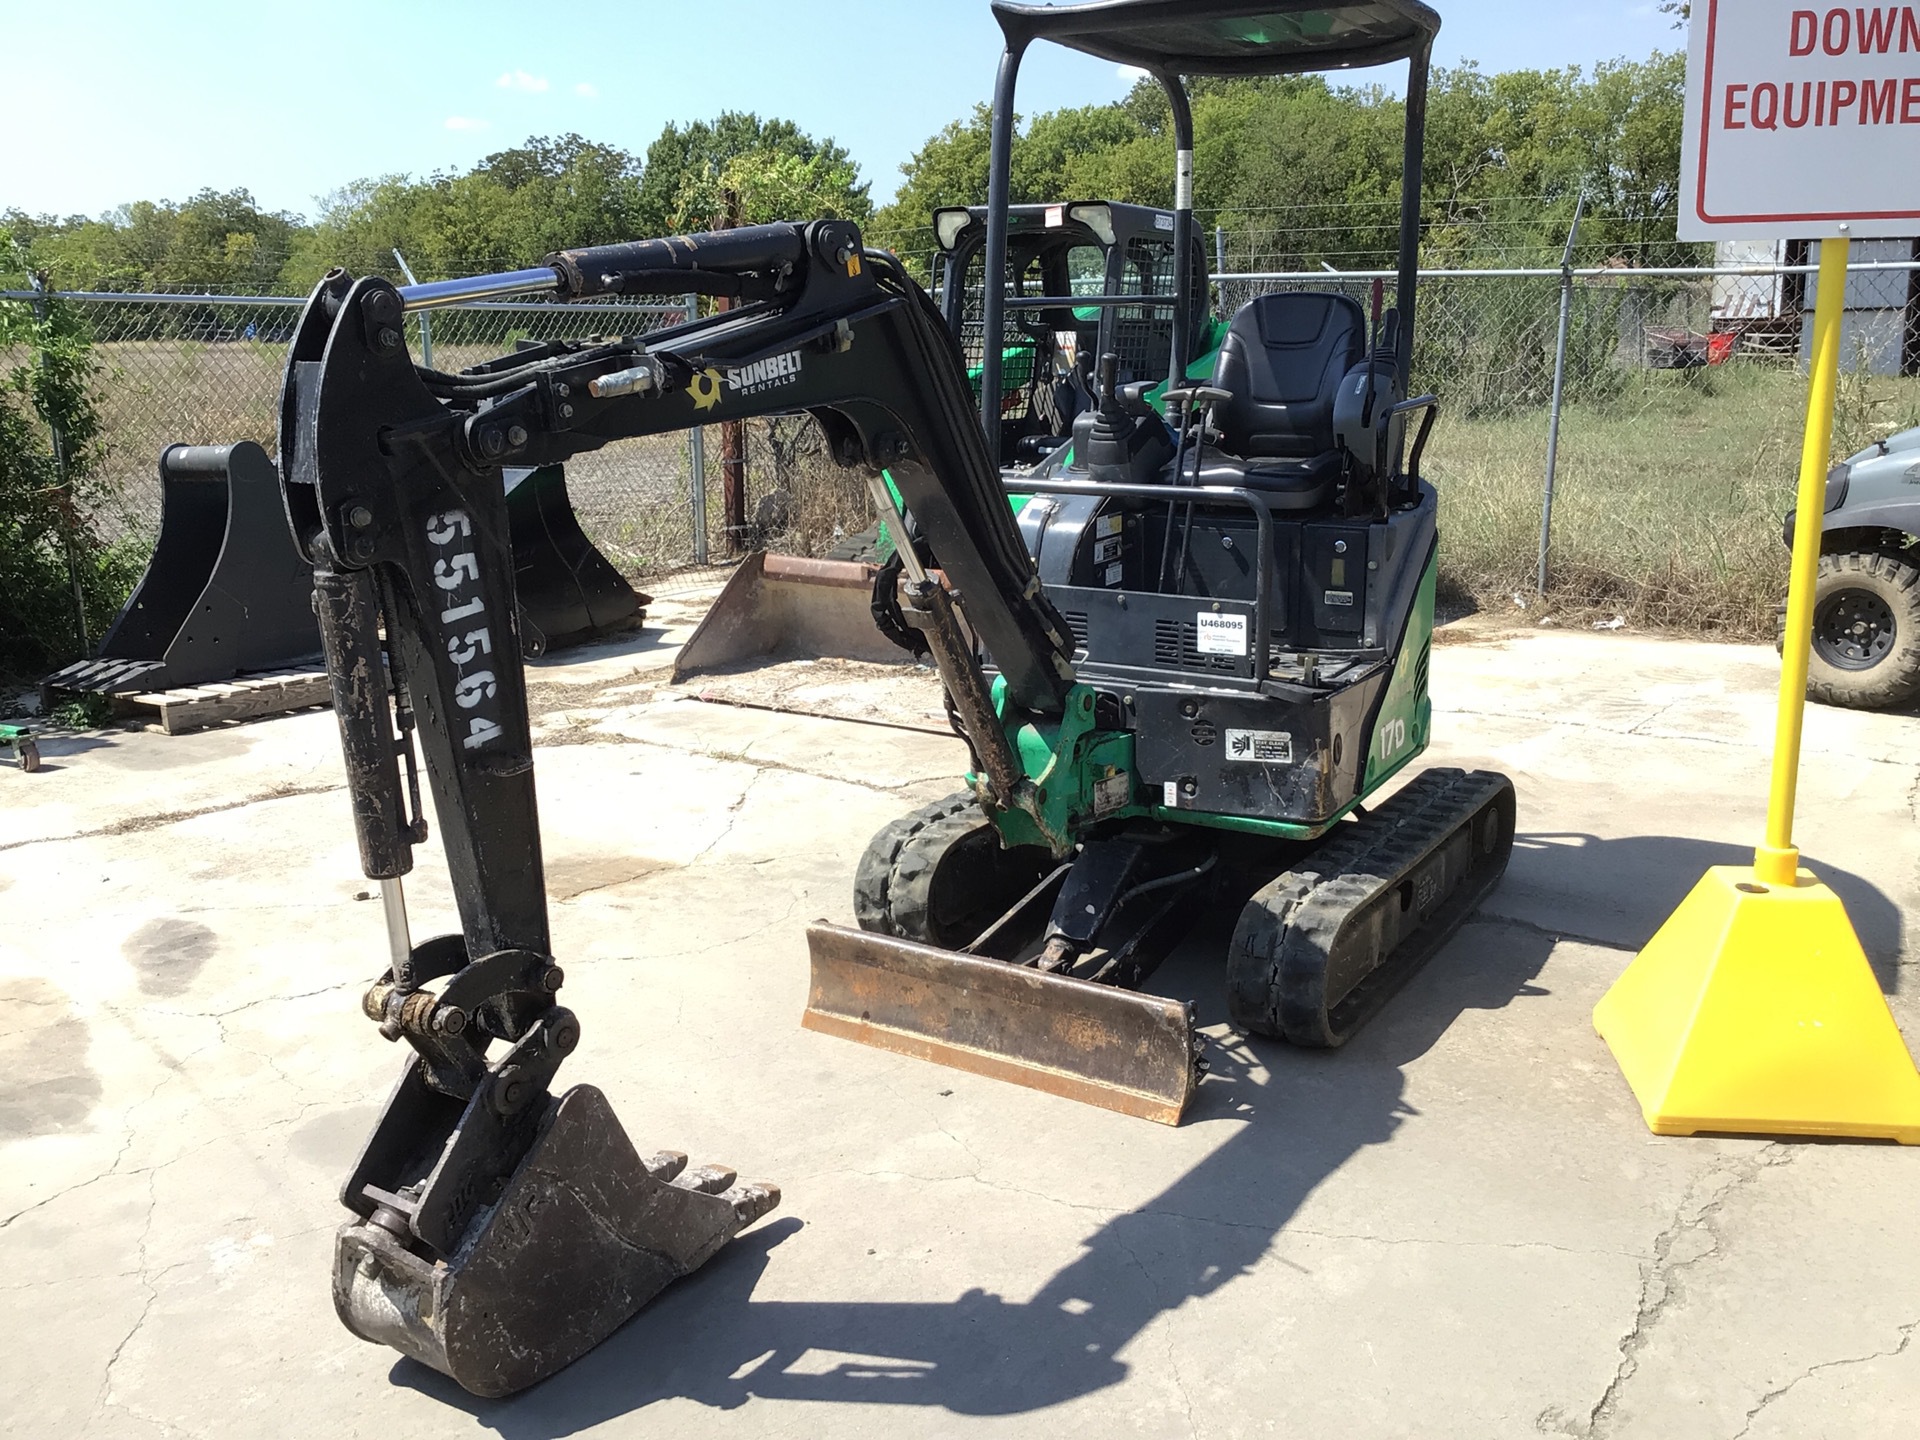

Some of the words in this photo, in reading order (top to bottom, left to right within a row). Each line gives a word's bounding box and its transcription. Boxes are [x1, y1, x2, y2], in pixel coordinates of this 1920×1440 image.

[1724, 78, 1920, 131] EQUIPME
[728, 350, 802, 390] SUNBELT
[742, 375, 797, 396] RENTALS
[427, 509, 503, 749] 551564
[1200, 619, 1243, 630] U468095
